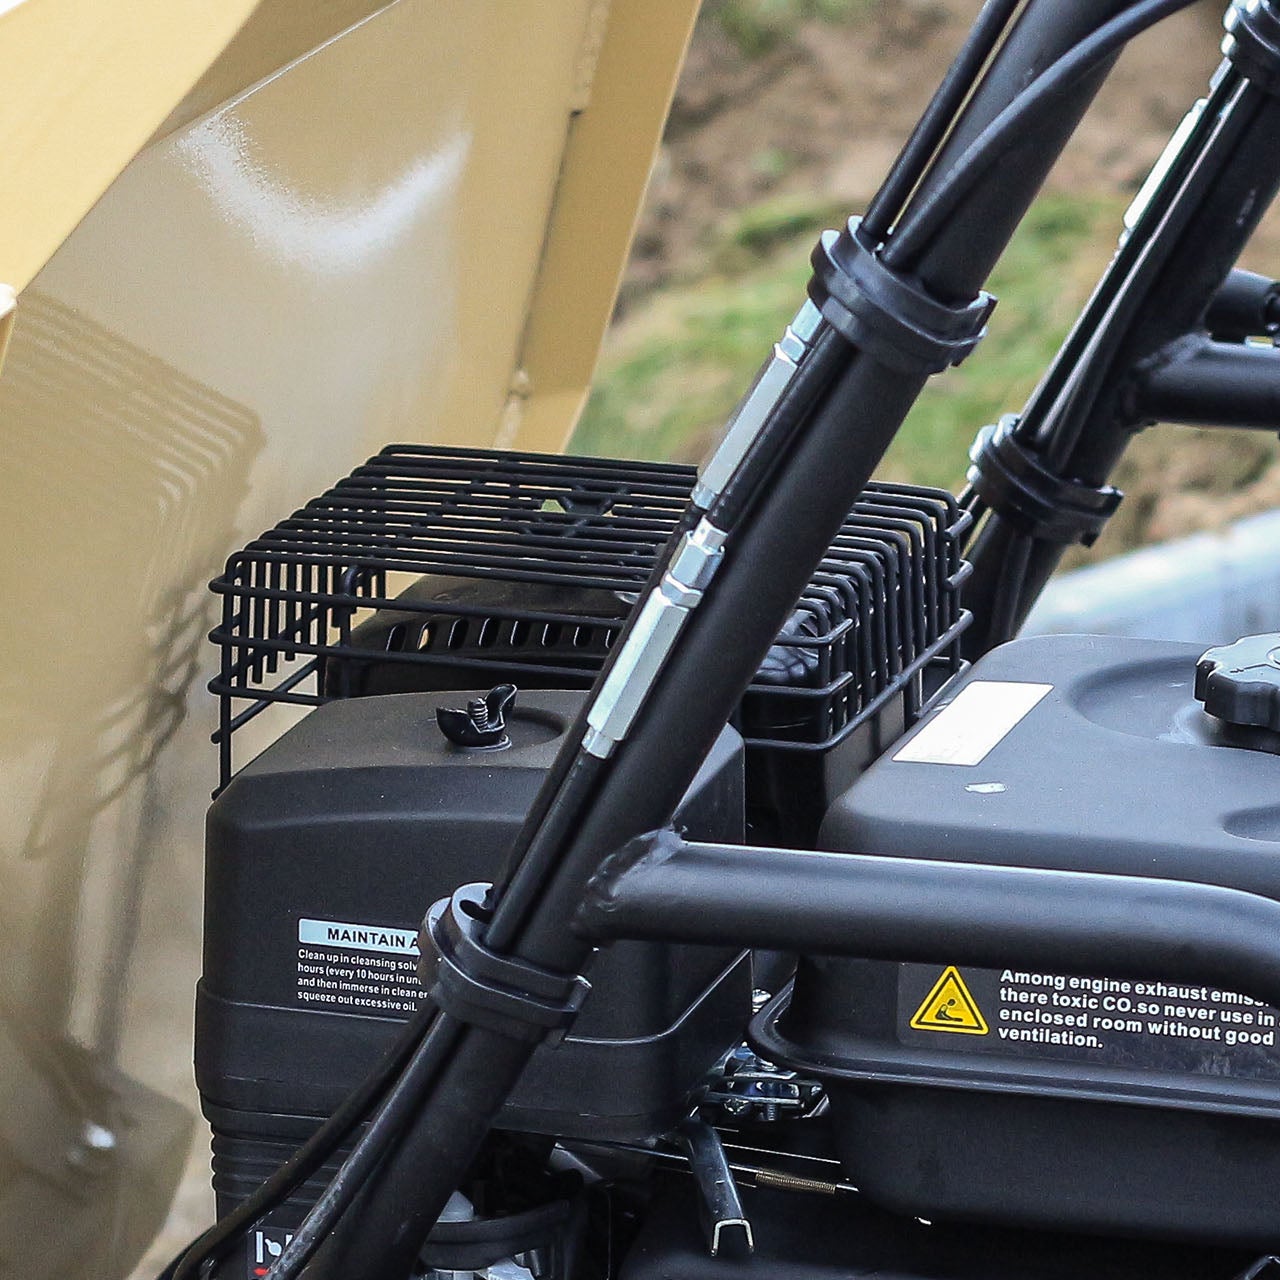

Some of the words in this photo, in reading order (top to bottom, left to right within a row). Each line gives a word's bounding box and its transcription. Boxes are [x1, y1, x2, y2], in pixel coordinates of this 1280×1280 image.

[328, 928, 405, 948] MAINTAIN
[298, 949, 325, 961] Clean
[326, 953, 339, 963] up
[340, 953, 350, 963] in
[351, 955, 396, 971] cleansing
[298, 962, 324, 974] hours
[325, 965, 354, 980] (every
[356, 969, 367, 979] 10
[368, 971, 394, 982] hours
[396, 973, 405, 983] in
[297, 977, 315, 987] and
[316, 978, 338, 989] then
[339, 980, 379, 994] immerse
[381, 985, 390, 995] in
[391, 986, 417, 998] clean
[1000, 969, 1066, 990] Among
[1069, 976, 1131, 995] engine
[1135, 982, 1207, 1001] exhaust
[297, 991, 336, 1003] squeeze
[338, 995, 353, 1005] out
[354, 998, 401, 1010] excessive
[403, 1002, 418, 1012] oil.
[1000, 988, 1048, 1005] there
[1052, 992, 1099, 1009] toxic
[1103, 996, 1160, 1015] CO.so
[1164, 1003, 1217, 1020] never
[1220, 1008, 1253, 1025] use
[1257, 1011, 1275, 1027] in
[998, 1026, 1104, 1049] ventilation.
[999, 1008, 1088, 1028] enclosed
[1093, 1016, 1142, 1032] room
[1148, 1021, 1221, 1041] without
[1225, 1029, 1275, 1047] good
